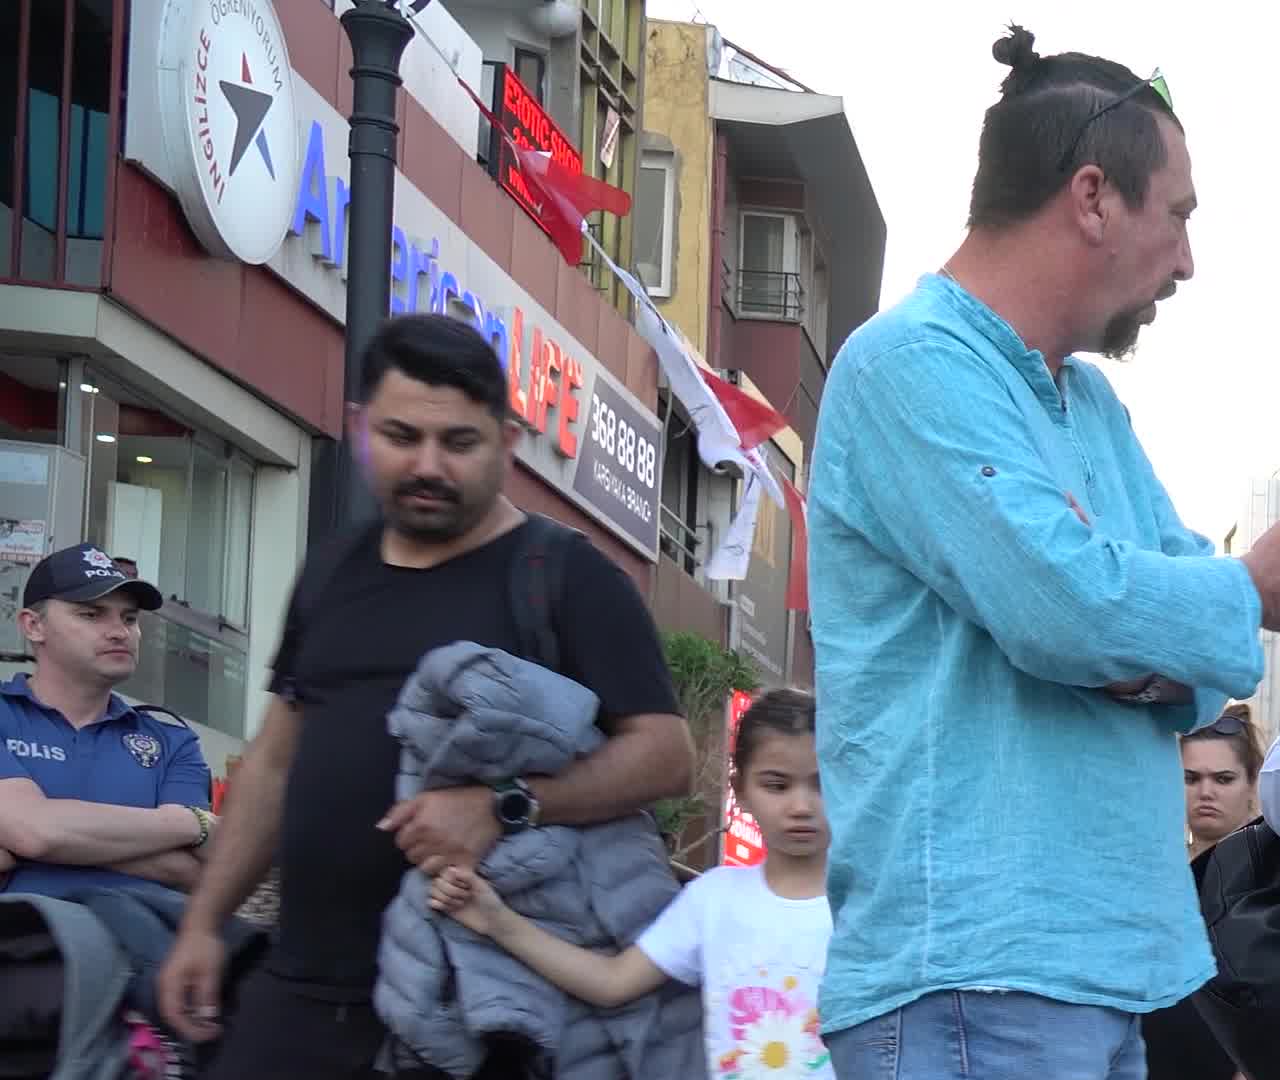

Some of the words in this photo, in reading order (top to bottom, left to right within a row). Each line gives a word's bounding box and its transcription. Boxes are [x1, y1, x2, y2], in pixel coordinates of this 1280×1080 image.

[592, 393, 616, 456] 368
[617, 418, 636, 473] 88
[637, 436, 656, 489] 88
